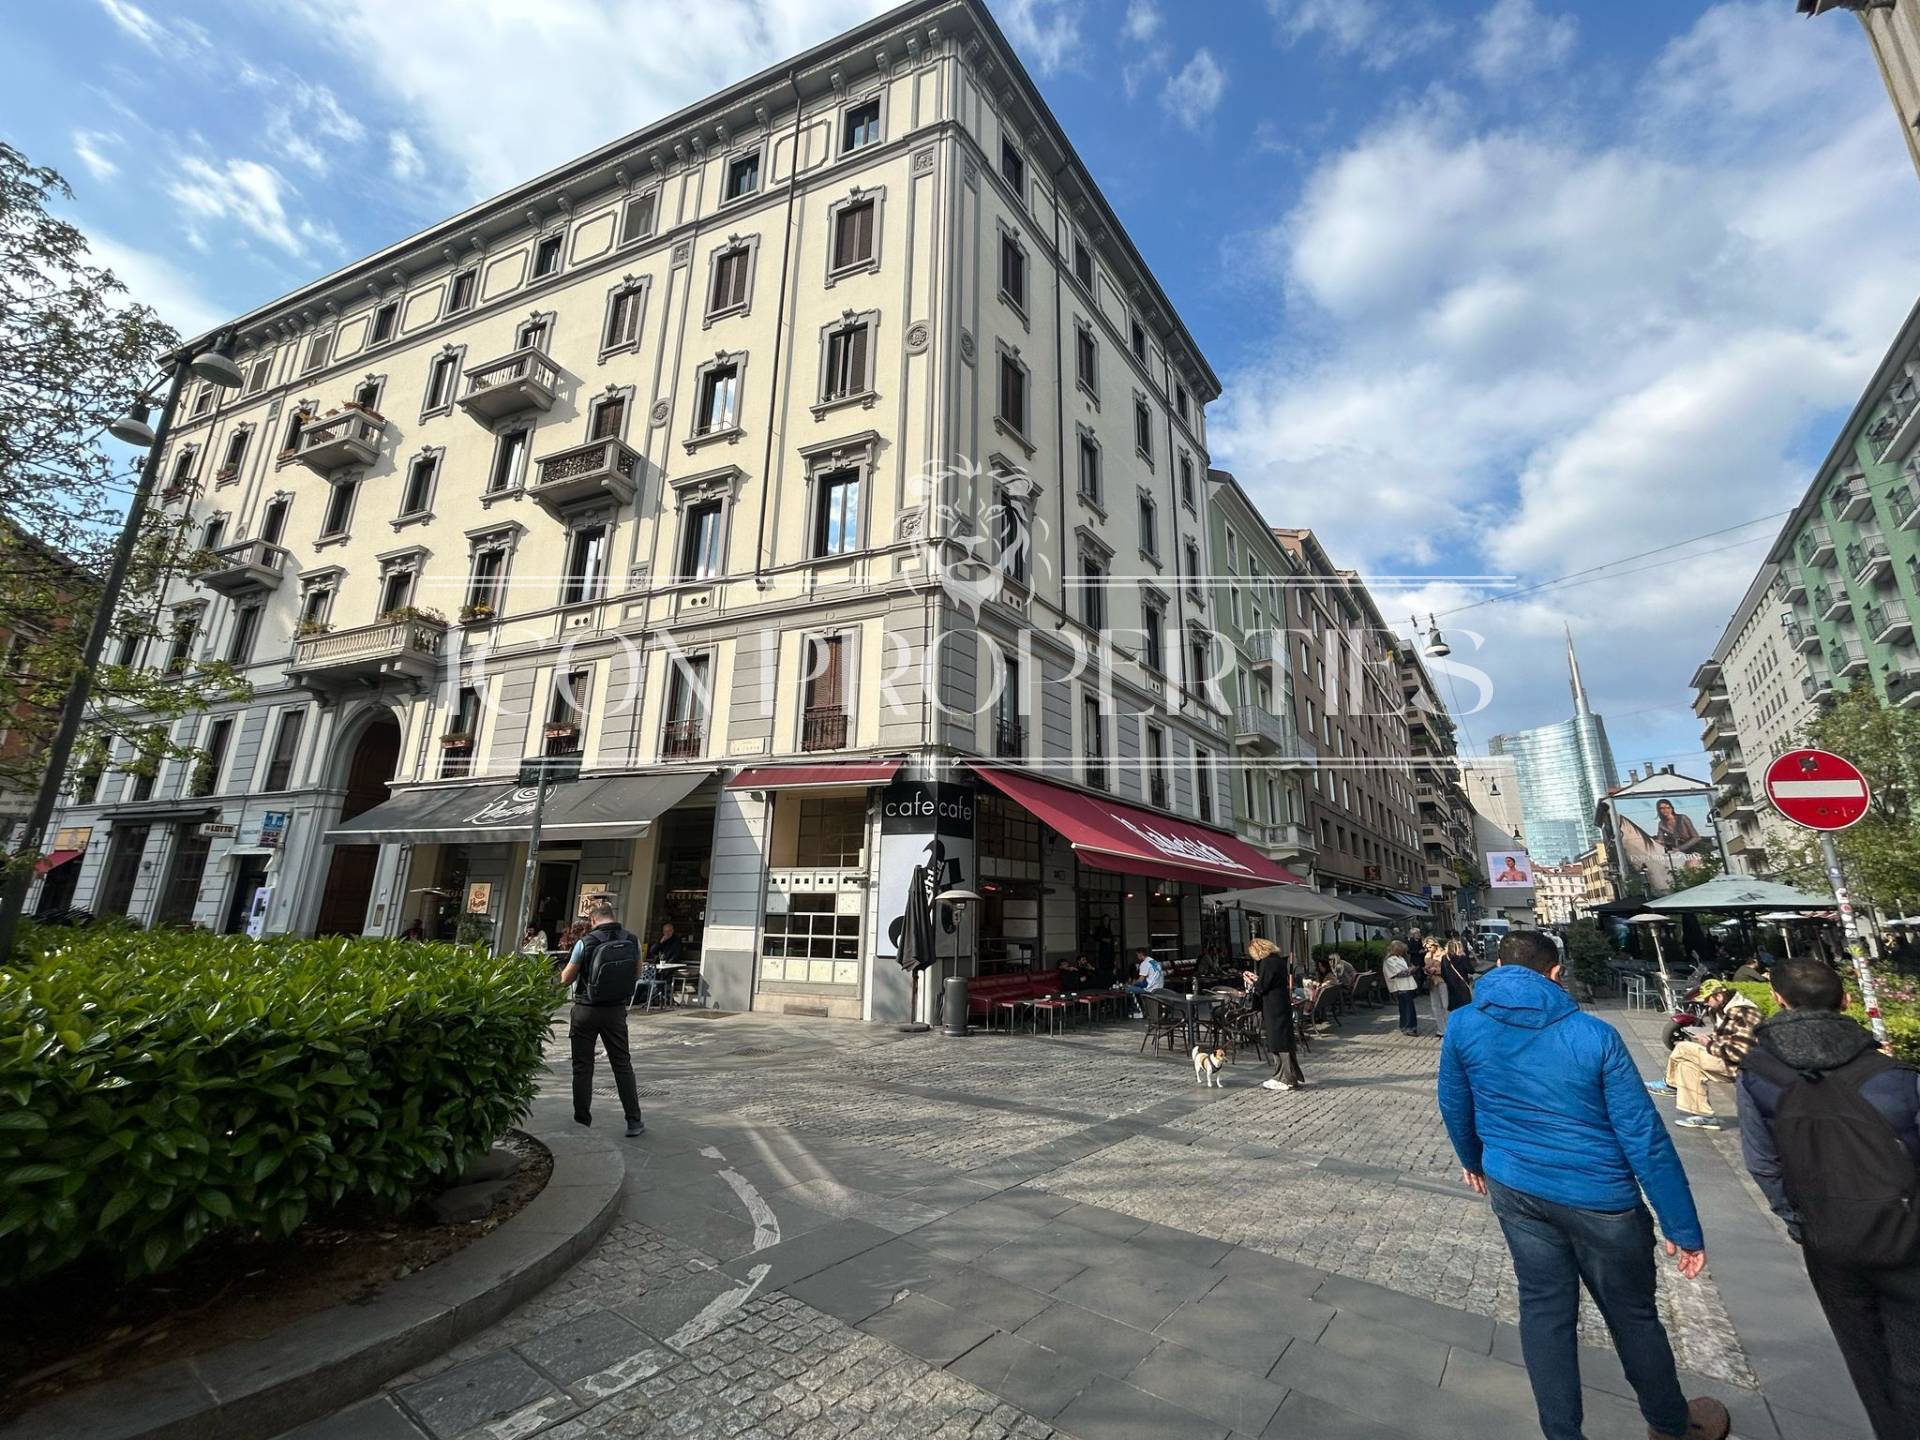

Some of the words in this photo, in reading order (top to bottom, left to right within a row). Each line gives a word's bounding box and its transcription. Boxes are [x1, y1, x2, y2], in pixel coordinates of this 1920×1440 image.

[885, 791, 935, 817] cafe
[938, 796, 972, 820] cafe
[210, 825, 233, 833] LOTTO
